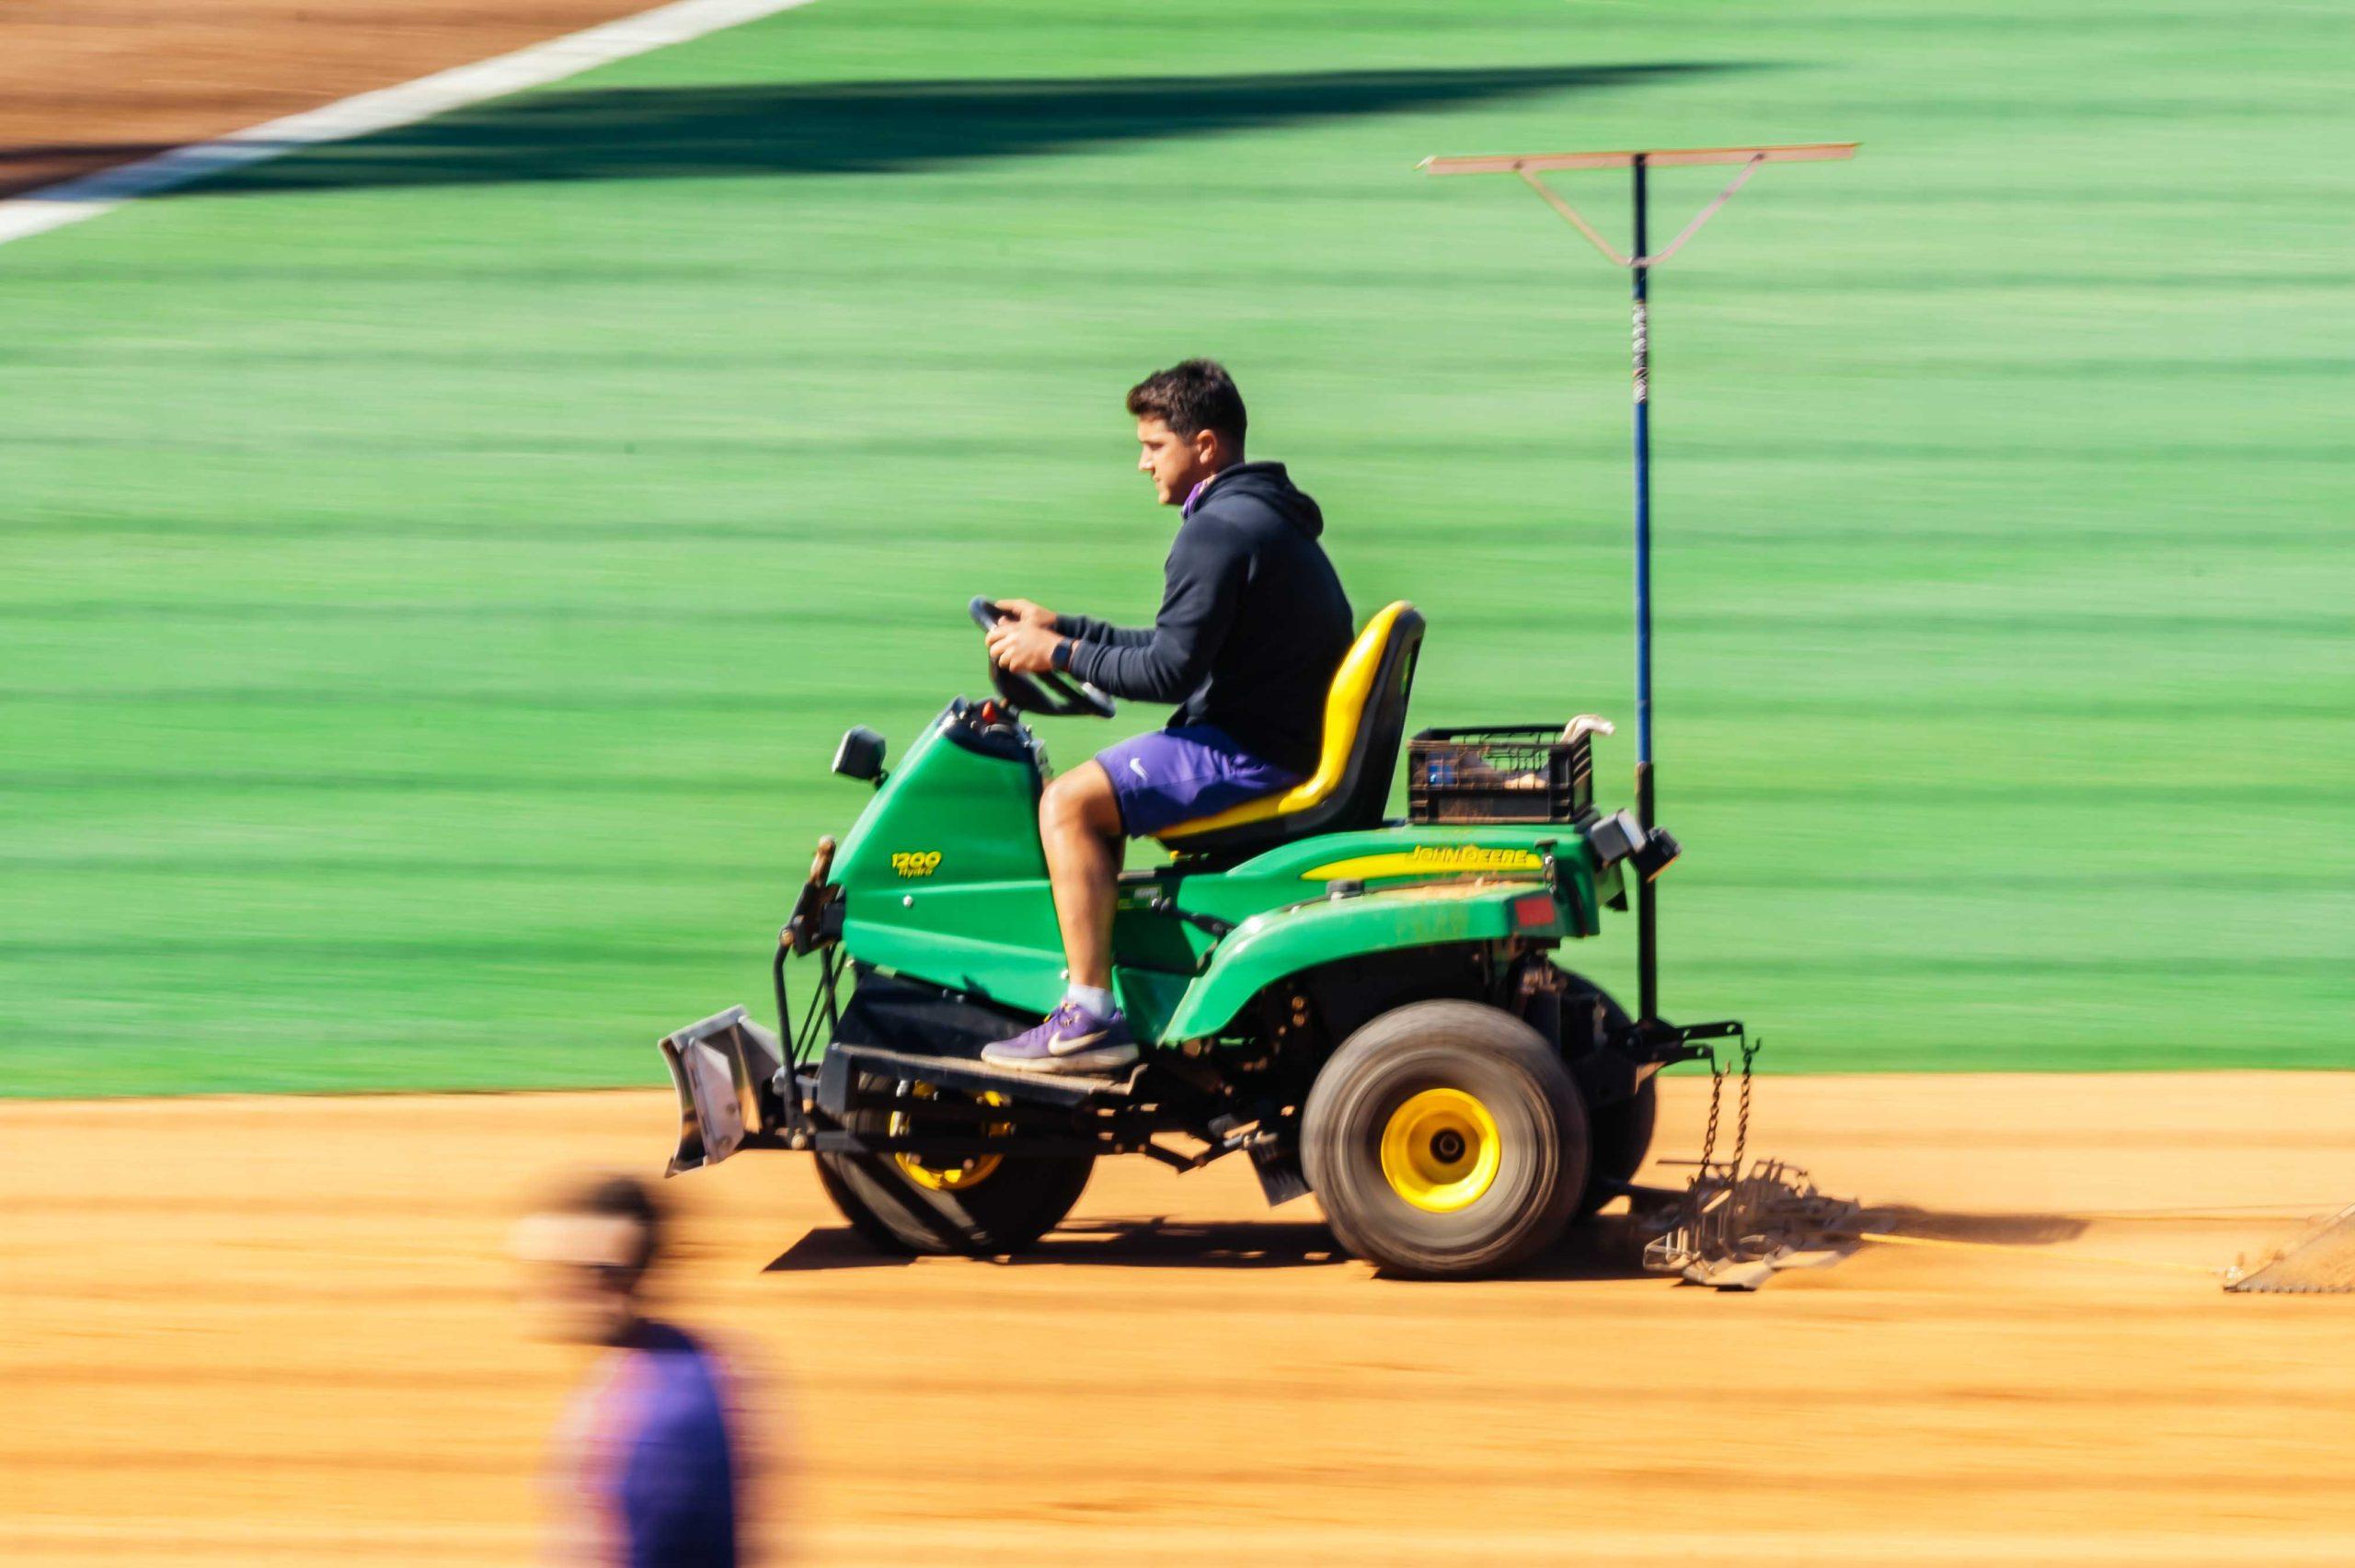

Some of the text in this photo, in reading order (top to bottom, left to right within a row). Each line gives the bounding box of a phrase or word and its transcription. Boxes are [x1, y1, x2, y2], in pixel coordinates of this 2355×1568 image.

[892, 851, 941, 868] 1200
[1411, 844, 1528, 863] JOHN DEERE
